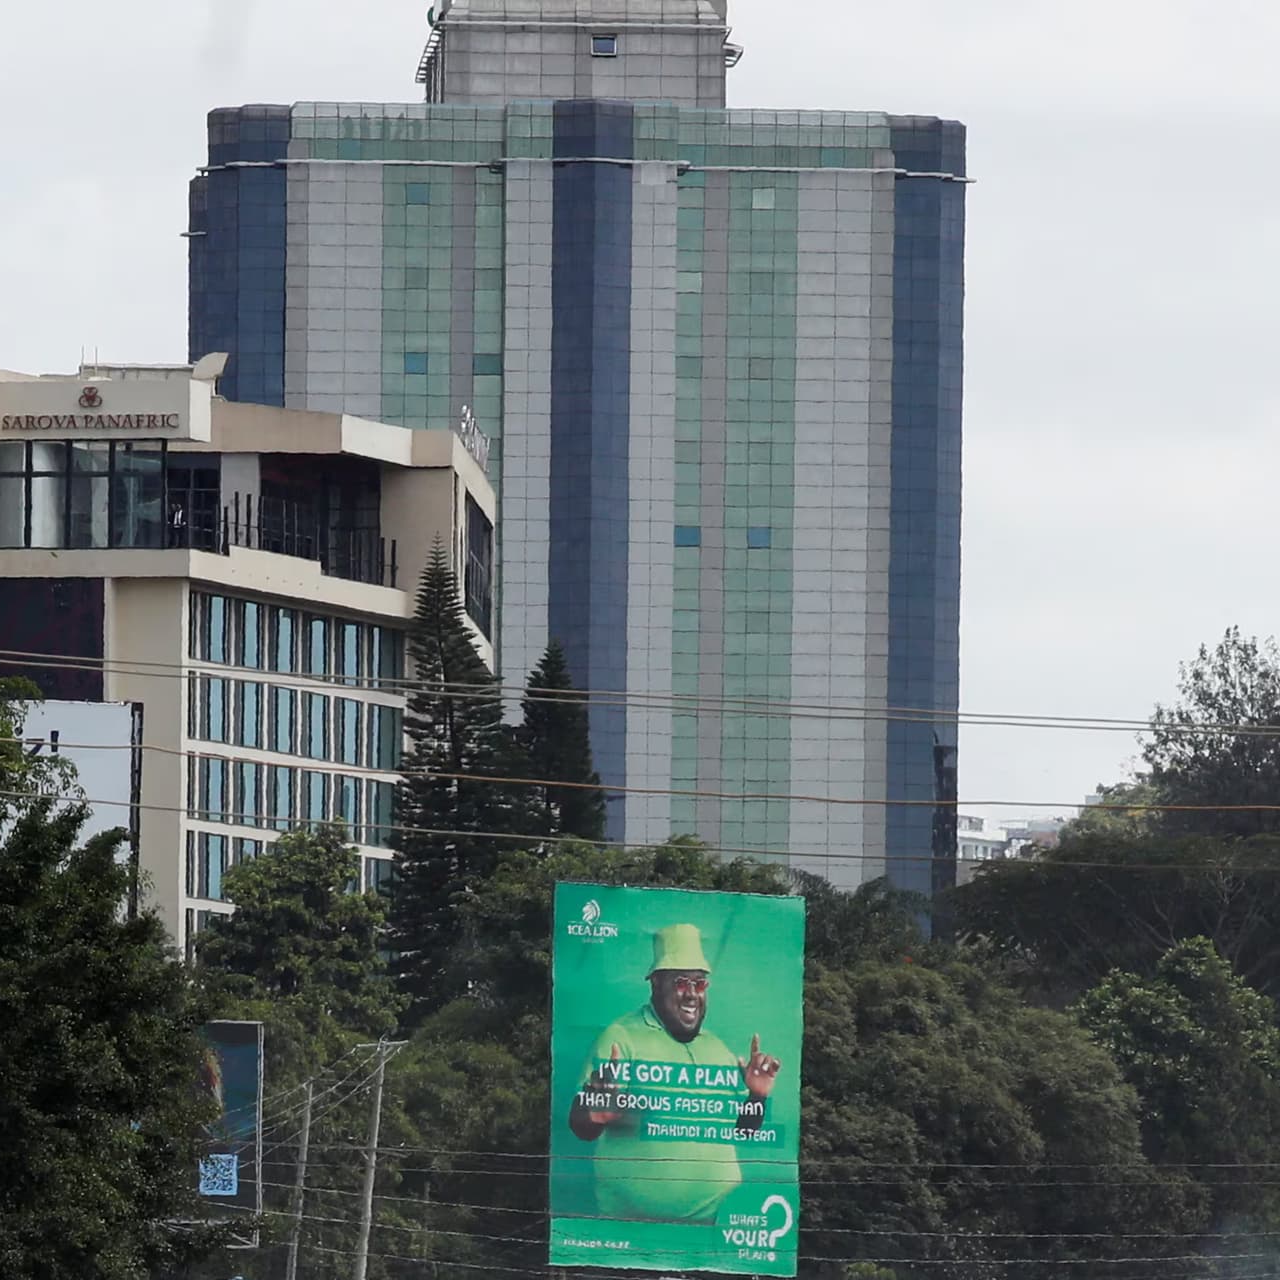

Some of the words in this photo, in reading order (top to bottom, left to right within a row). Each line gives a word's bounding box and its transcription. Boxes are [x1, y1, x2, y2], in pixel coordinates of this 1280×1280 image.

[2, 415, 78, 430] SAROVA
[84, 413, 180, 430] PANAFRIC
[567, 924, 591, 937] ICEA
[592, 925, 618, 937] LION
[599, 1062, 631, 1081] I'VE
[636, 1064, 673, 1084] GOT
[677, 1067, 690, 1086] A
[695, 1068, 739, 1088] PLAN
[577, 1091, 612, 1108] THAT
[616, 1094, 671, 1112] GROWS
[674, 1098, 724, 1114] FASTER
[728, 1100, 764, 1116] THAN
[704, 1126, 717, 1139] IN
[721, 1127, 776, 1142] WESTERN
[722, 1229, 769, 1248] YOUR
